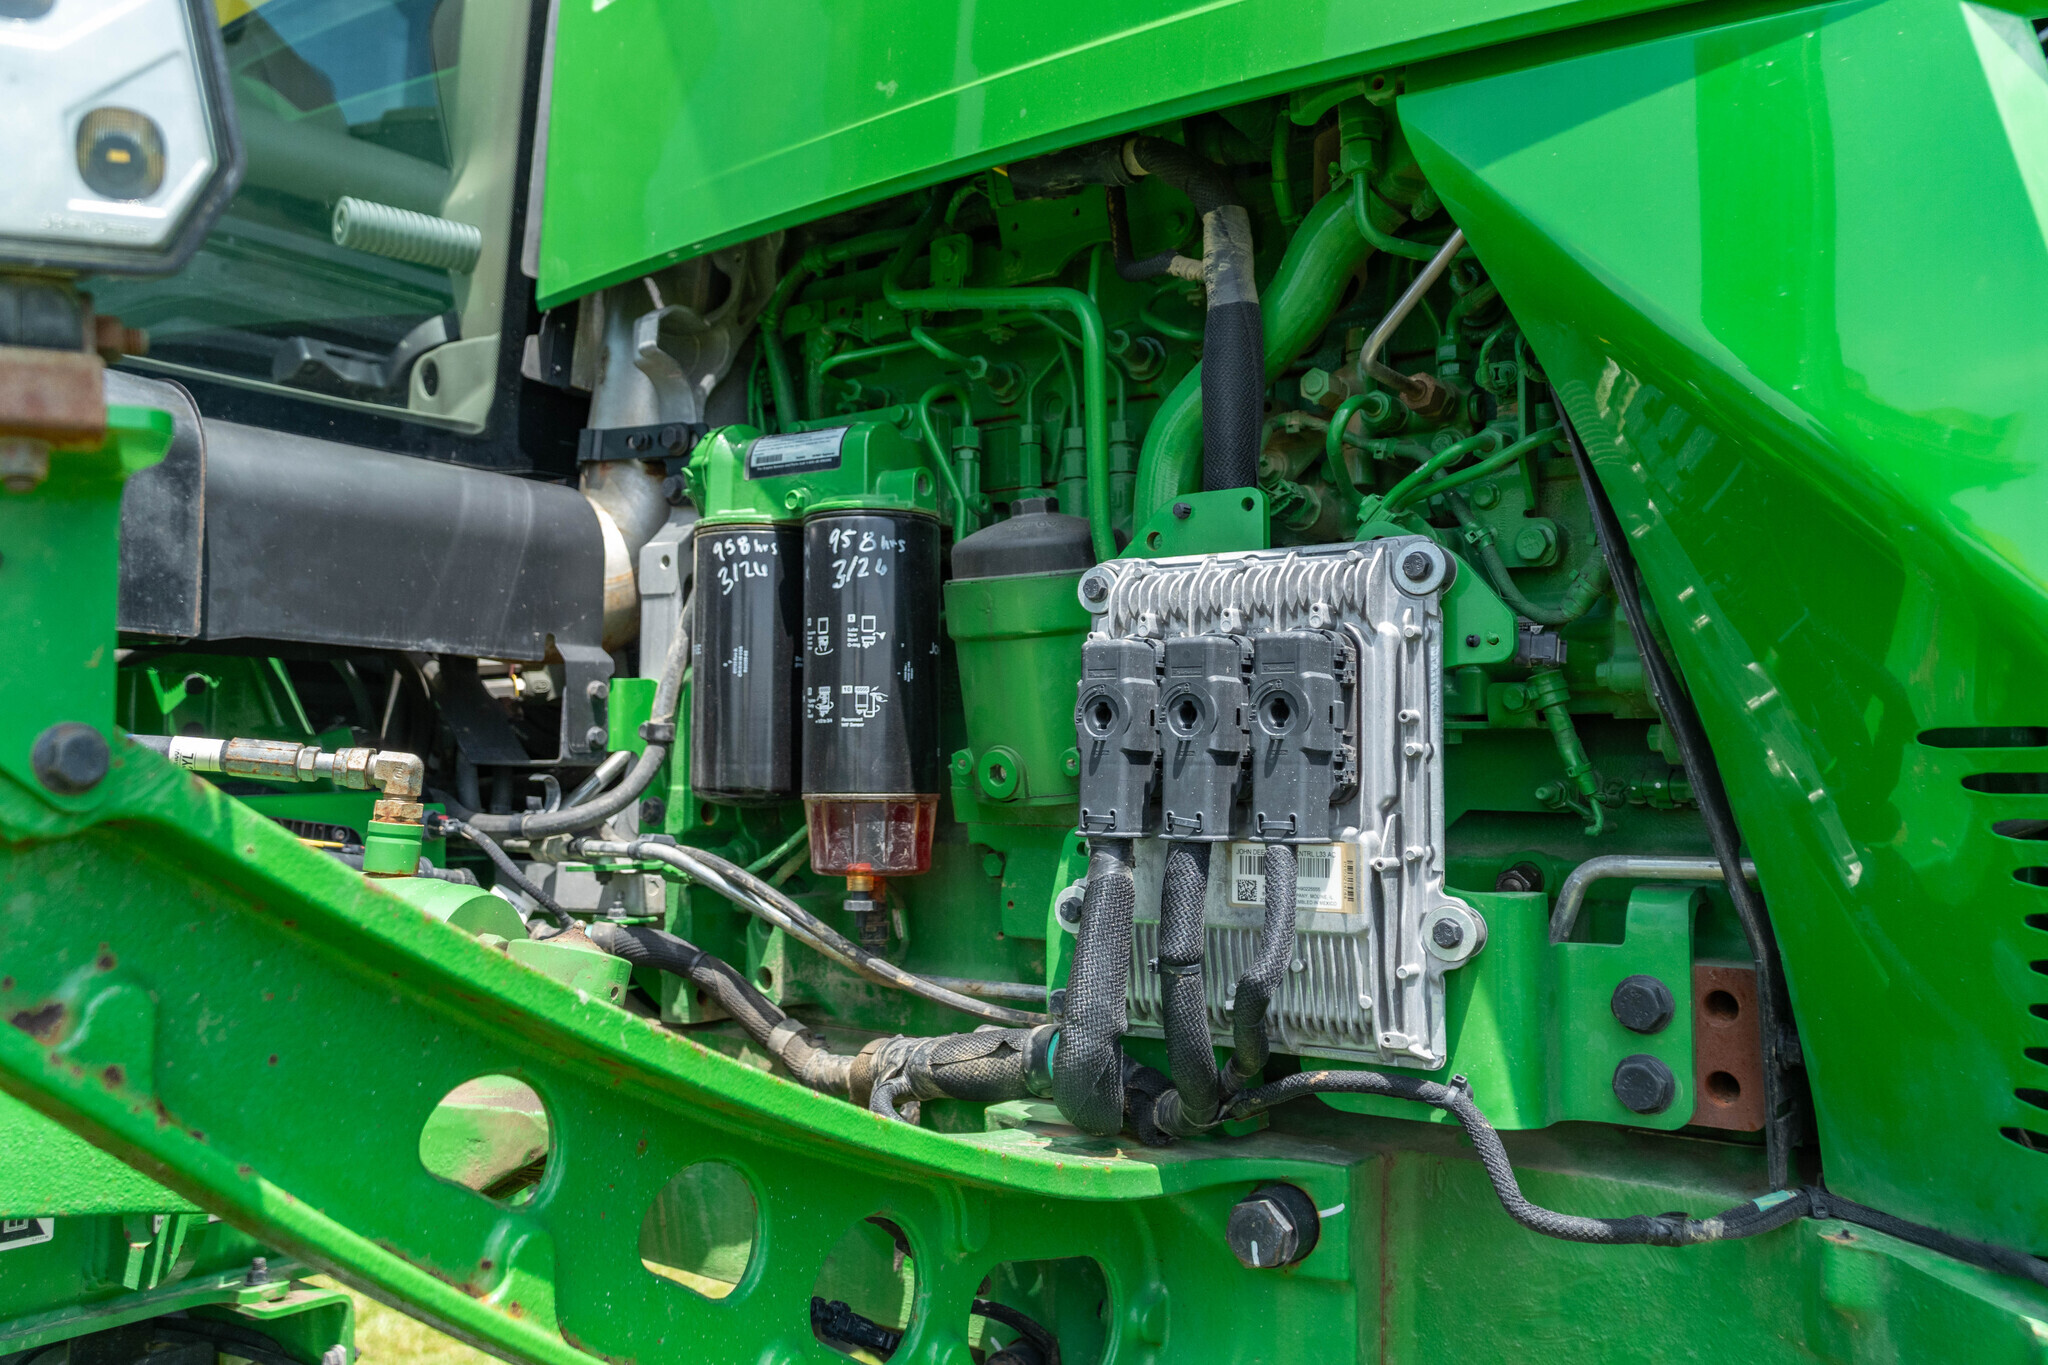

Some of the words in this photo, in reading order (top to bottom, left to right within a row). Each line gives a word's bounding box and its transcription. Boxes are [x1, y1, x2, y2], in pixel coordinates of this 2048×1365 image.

[712, 535, 751, 562] 958
[753, 538, 778, 556] hrs
[829, 527, 877, 555] 958
[880, 535, 907, 553] hrs
